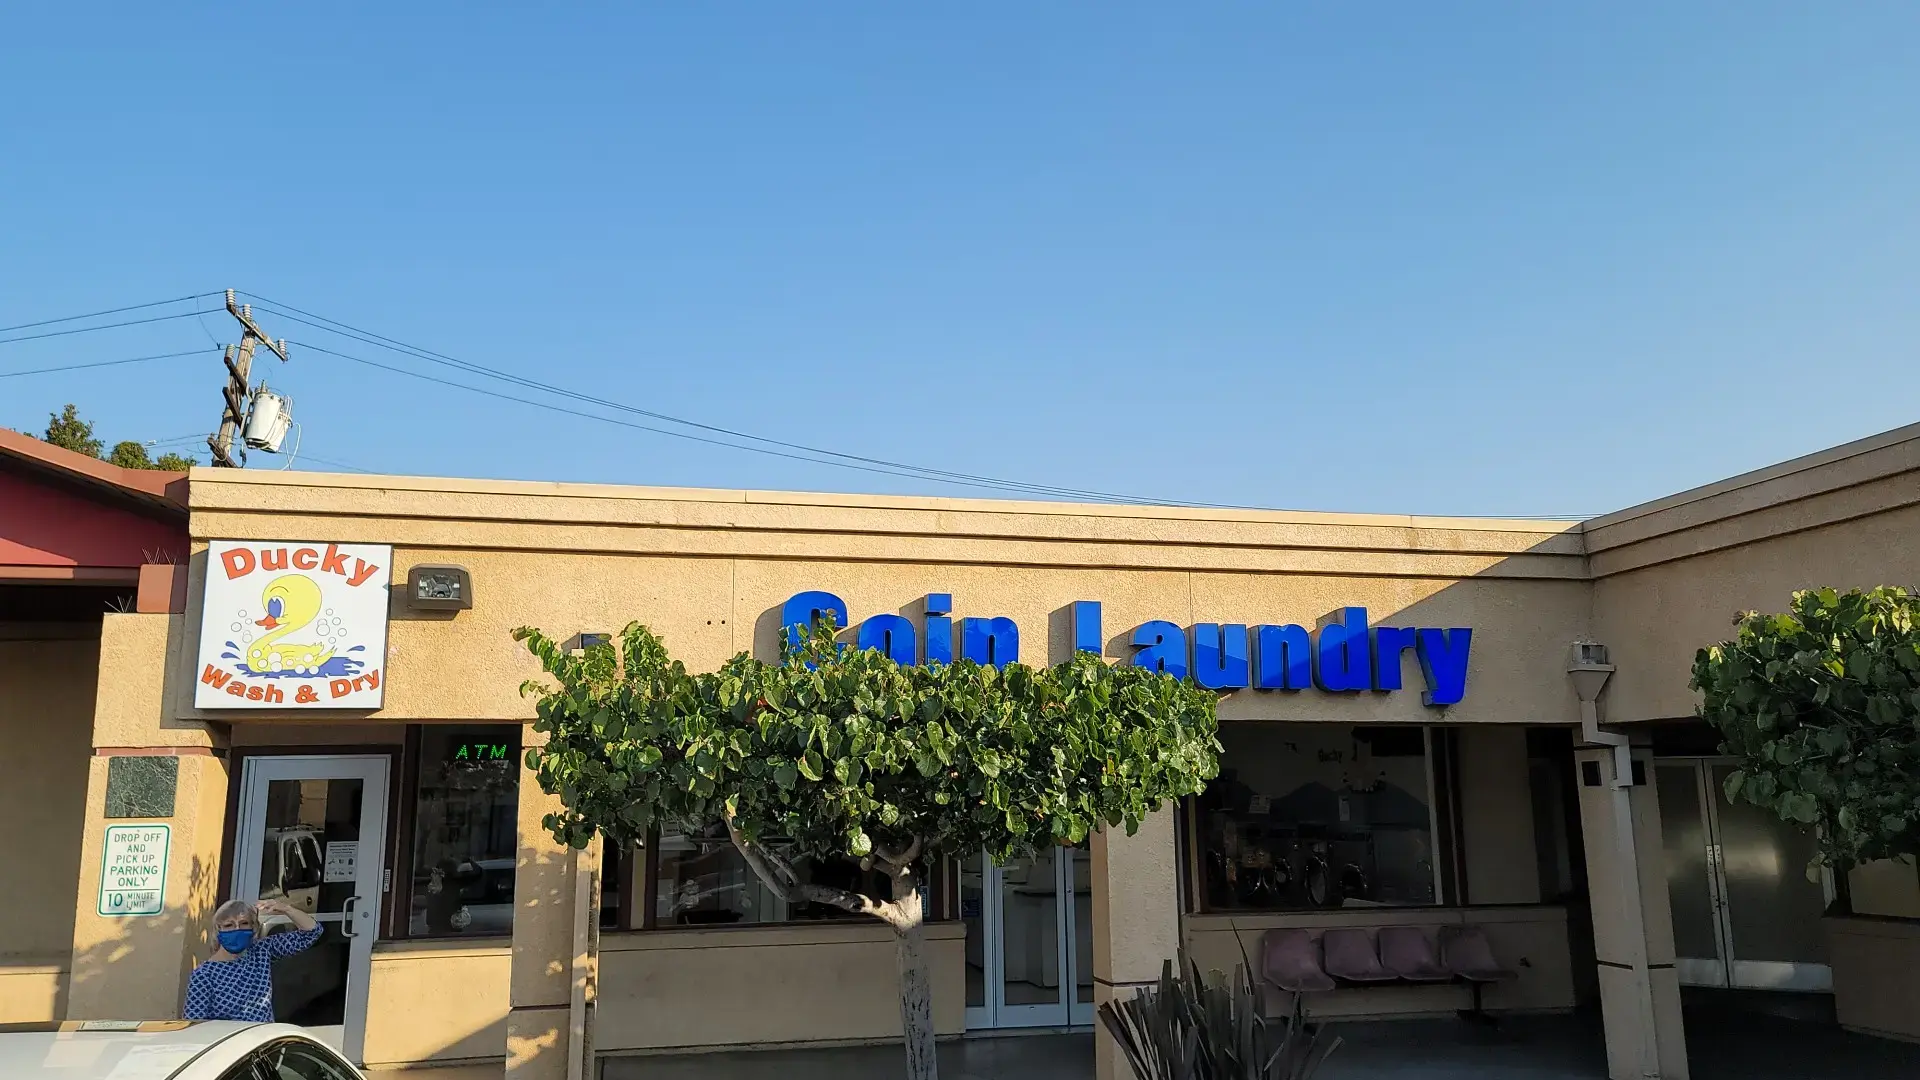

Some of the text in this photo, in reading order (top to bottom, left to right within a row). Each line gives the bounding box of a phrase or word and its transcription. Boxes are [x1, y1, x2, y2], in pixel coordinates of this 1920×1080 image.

[220, 544, 380, 587] Ducky
[782, 591, 1473, 706] Coin Laundry
[201, 663, 380, 703] Wash & Dry
[455, 744, 507, 760] ATM
[114, 833, 162, 842] DROP OFF
[127, 844, 146, 853] AND
[116, 854, 155, 864] PICK UP
[110, 865, 158, 875] PARKING
[118, 877, 148, 887] ONLY
[108, 892, 155, 907] 10 MINUTE
[126, 901, 146, 909] LIMIT
